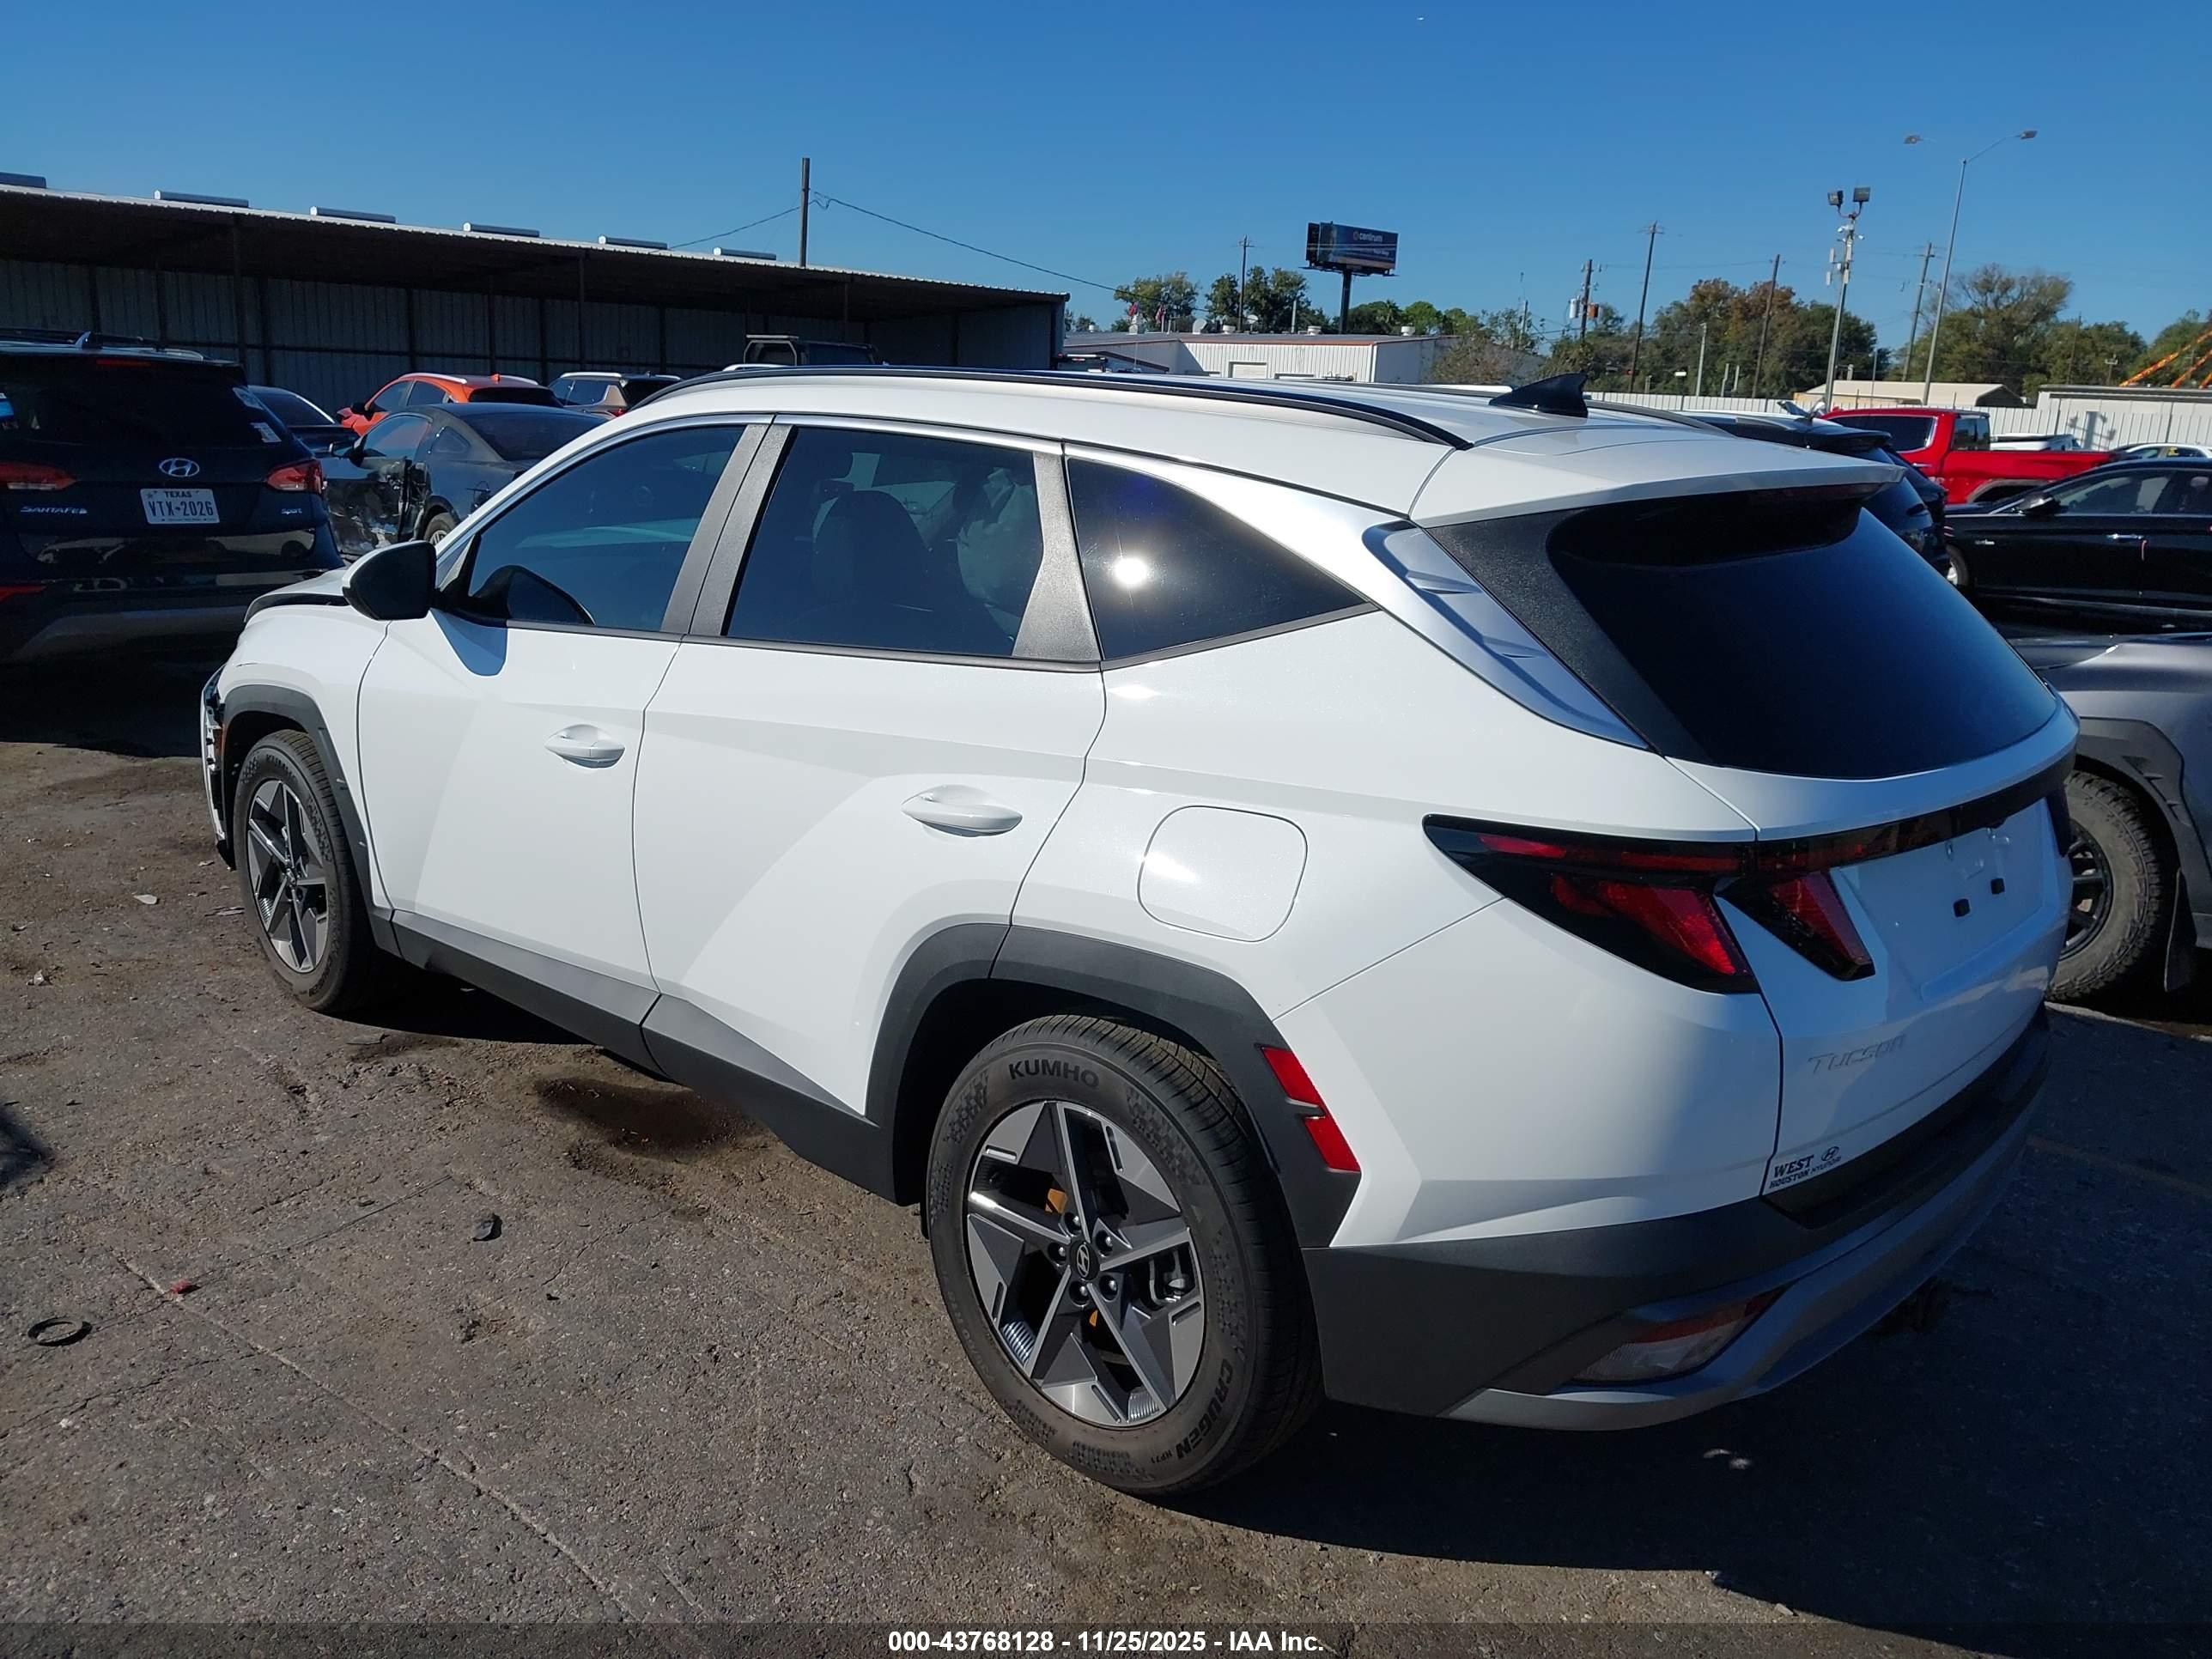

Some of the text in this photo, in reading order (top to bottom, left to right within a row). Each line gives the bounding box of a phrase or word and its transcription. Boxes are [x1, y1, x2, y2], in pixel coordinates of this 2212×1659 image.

[1008, 1059, 1099, 1088] KUMHO
[1770, 1169, 1810, 1188] HOUSTON
[1774, 1154, 1814, 1177] WEST
[1175, 1358, 1234, 1459] CRUGEN
